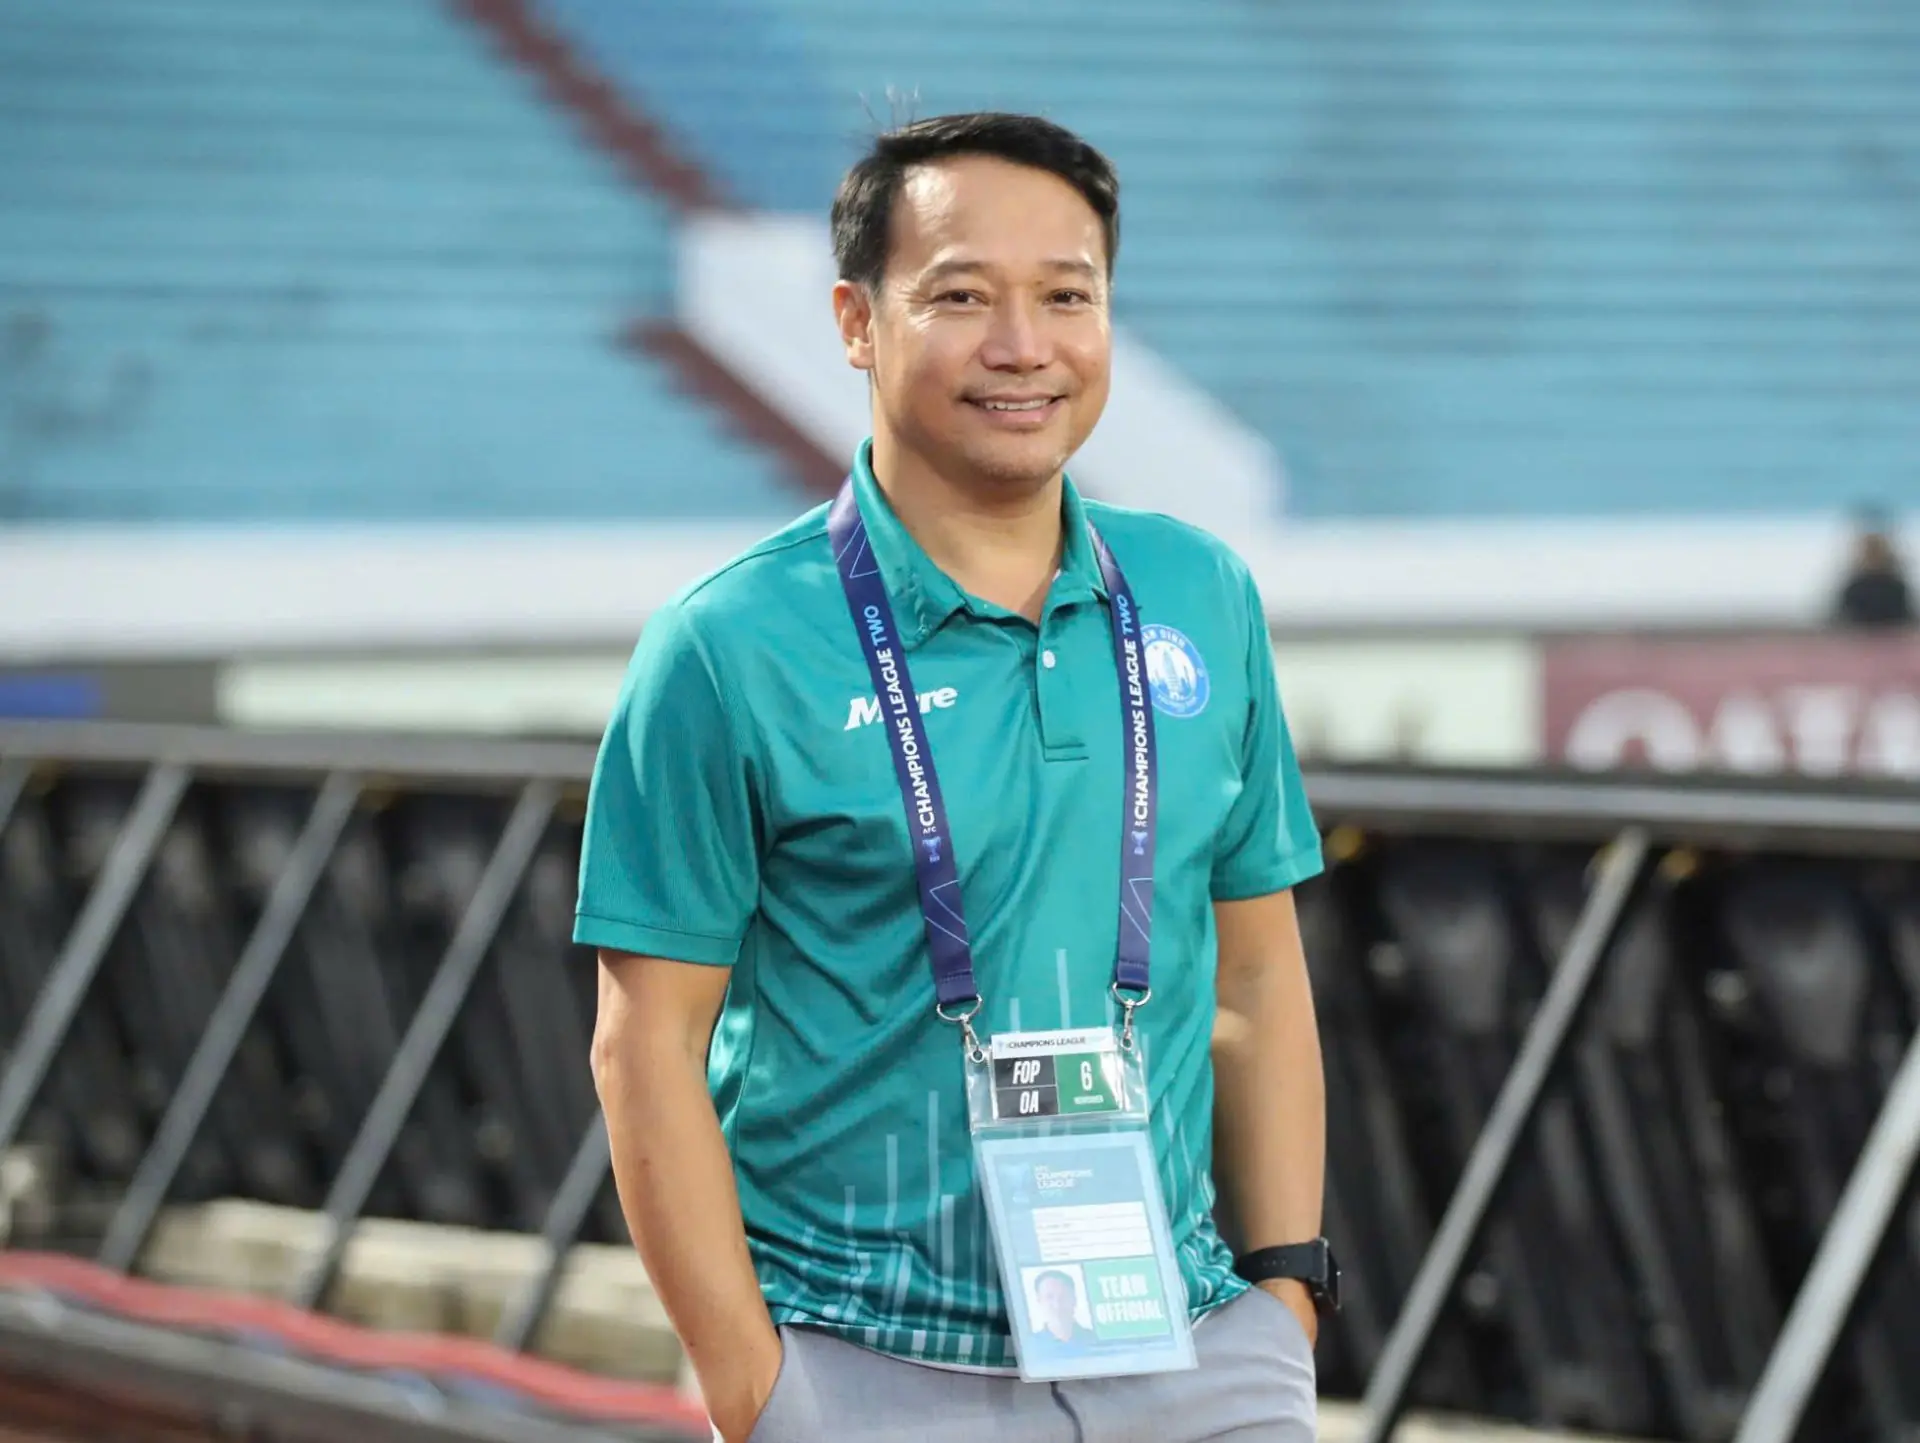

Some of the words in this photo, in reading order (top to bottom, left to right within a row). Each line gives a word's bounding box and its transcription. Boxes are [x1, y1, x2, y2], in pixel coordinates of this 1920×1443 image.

[864, 605, 888, 647] TWO
[1116, 594, 1135, 636] TWO
[876, 647, 908, 715] LEAGUE
[1124, 638, 1144, 707] LEAGUE
[844, 687, 958, 731] Mre
[896, 717, 935, 827] CHAMPIONS
[1132, 709, 1149, 820] CHAMPIONS
[923, 826, 937, 834] AFC
[1008, 1038, 1055, 1050] CHAMPIONS
[1056, 1036, 1086, 1046] LEAGUE
[1012, 1060, 1041, 1084] FOP
[1080, 1061, 1093, 1091] 6
[1020, 1091, 1039, 1114] OA
